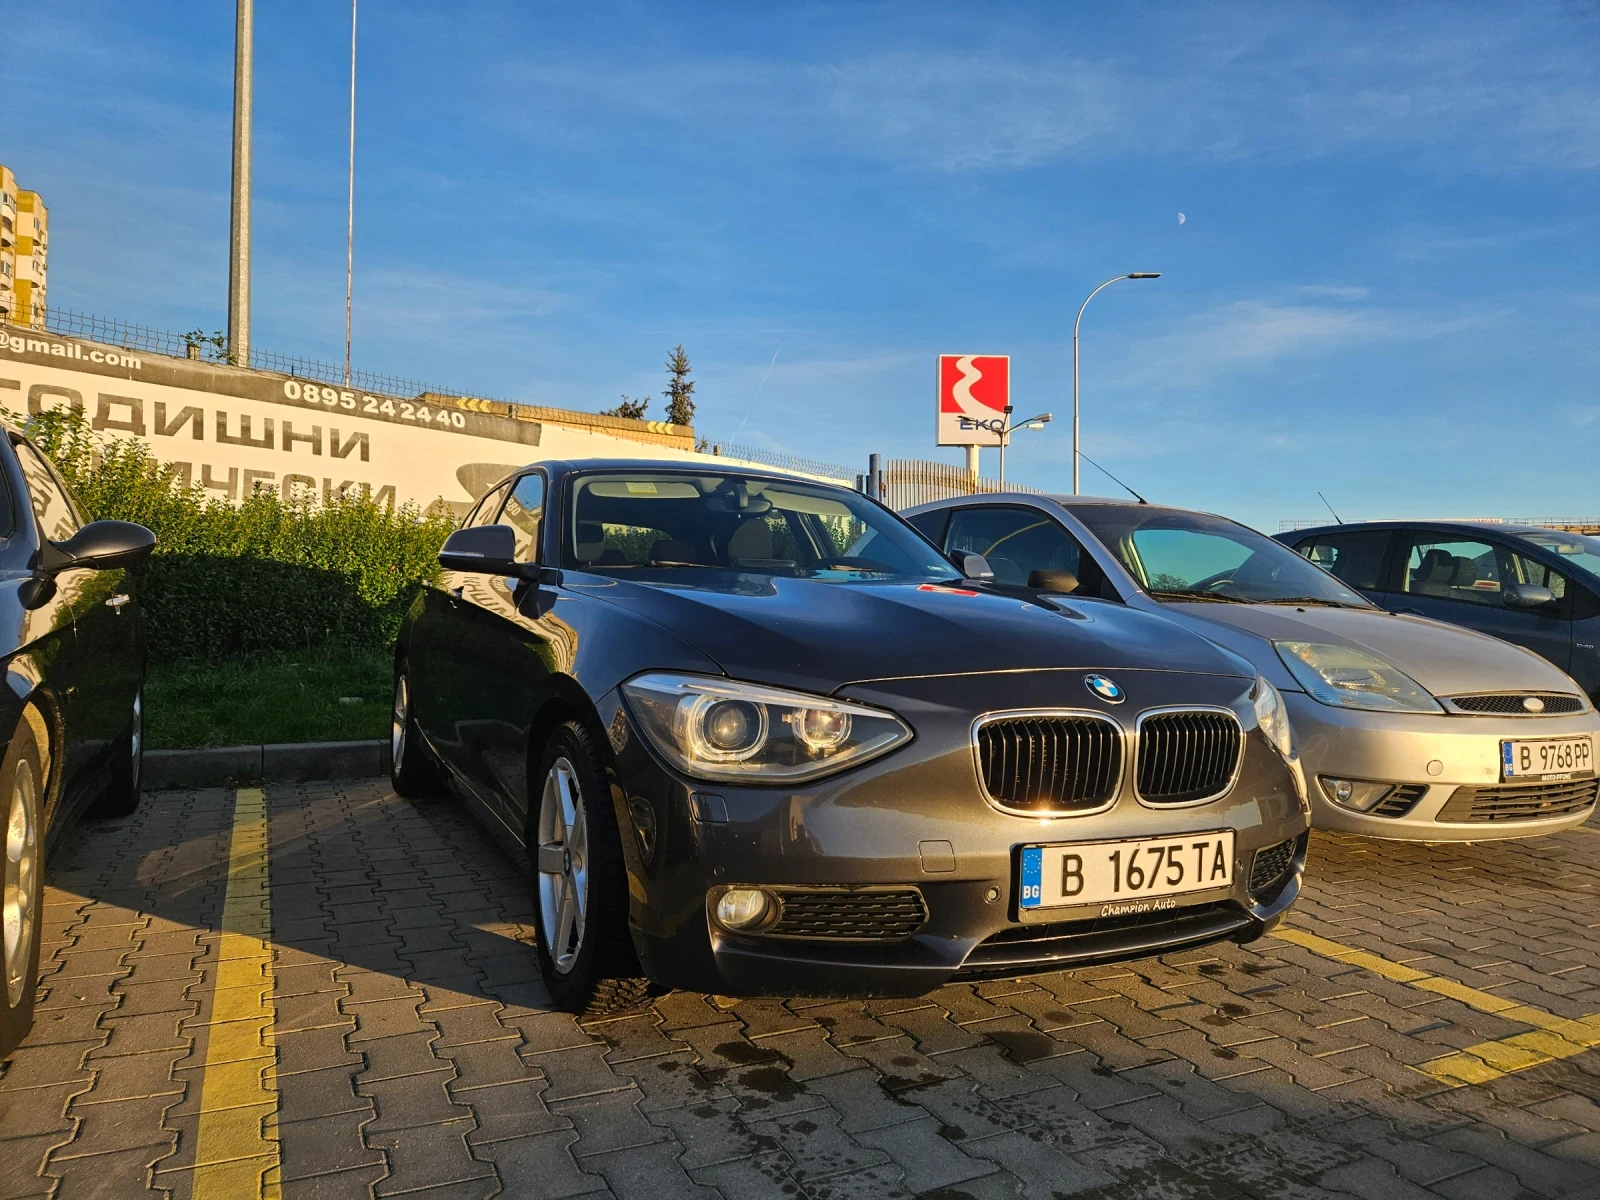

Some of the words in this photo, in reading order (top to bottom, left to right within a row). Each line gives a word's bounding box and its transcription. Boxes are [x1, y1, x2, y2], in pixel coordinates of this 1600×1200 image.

[283, 380, 356, 410] 0895
[362, 395, 396, 417] 24
[400, 402, 432, 423] 24
[436, 409, 466, 428] 40
[960, 418, 1004, 431] EKO
[1520, 746, 1532, 771] B
[1540, 743, 1573, 770] 9768
[1574, 742, 1589, 768] PP
[1505, 763, 1513, 771] BG
[1061, 853, 1084, 897] B
[1108, 844, 1184, 893] 1675
[1192, 840, 1227, 883] TA
[1023, 885, 1040, 899] BG
[1101, 901, 1150, 917] Champion
[1153, 899, 1176, 911] Auto
